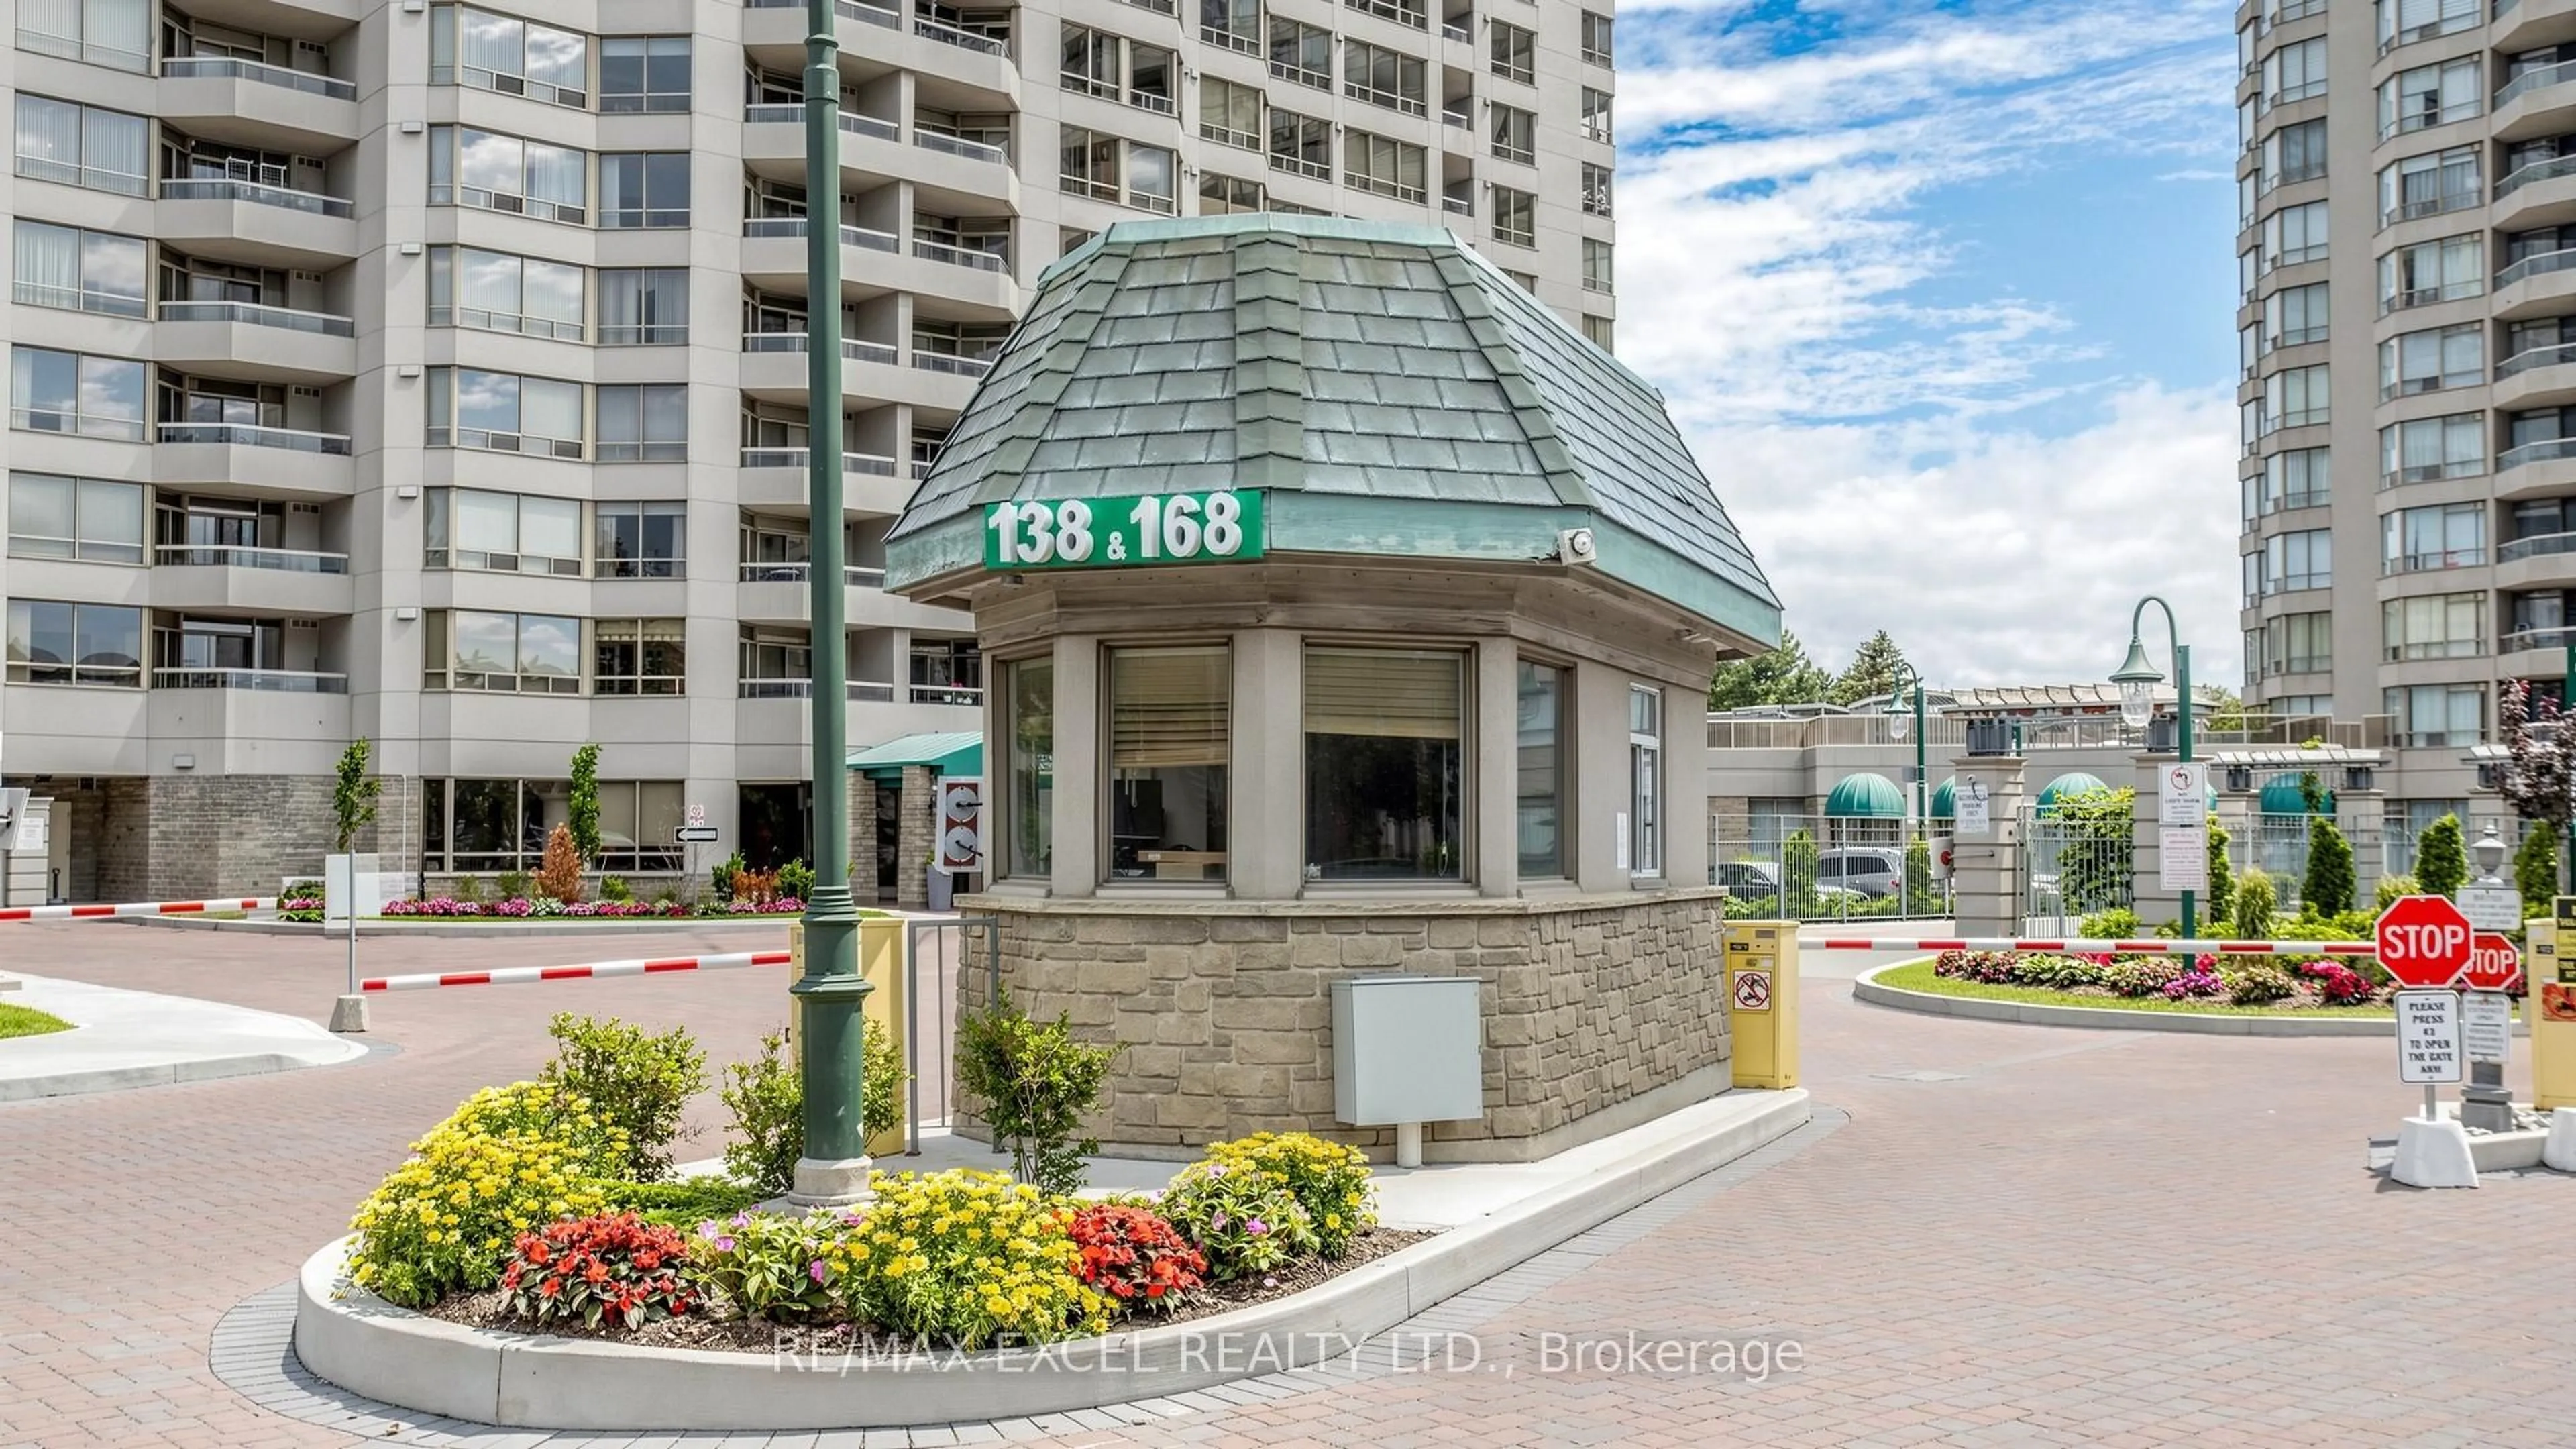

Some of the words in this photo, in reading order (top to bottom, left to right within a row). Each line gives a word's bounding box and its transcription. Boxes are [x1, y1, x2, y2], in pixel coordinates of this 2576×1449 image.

[989, 500, 1094, 563] 138
[1107, 531, 1126, 560] &
[1130, 492, 1242, 558] 168
[2384, 924, 2465, 959] STOP
[2409, 1002, 2445, 1011] PLEASE
